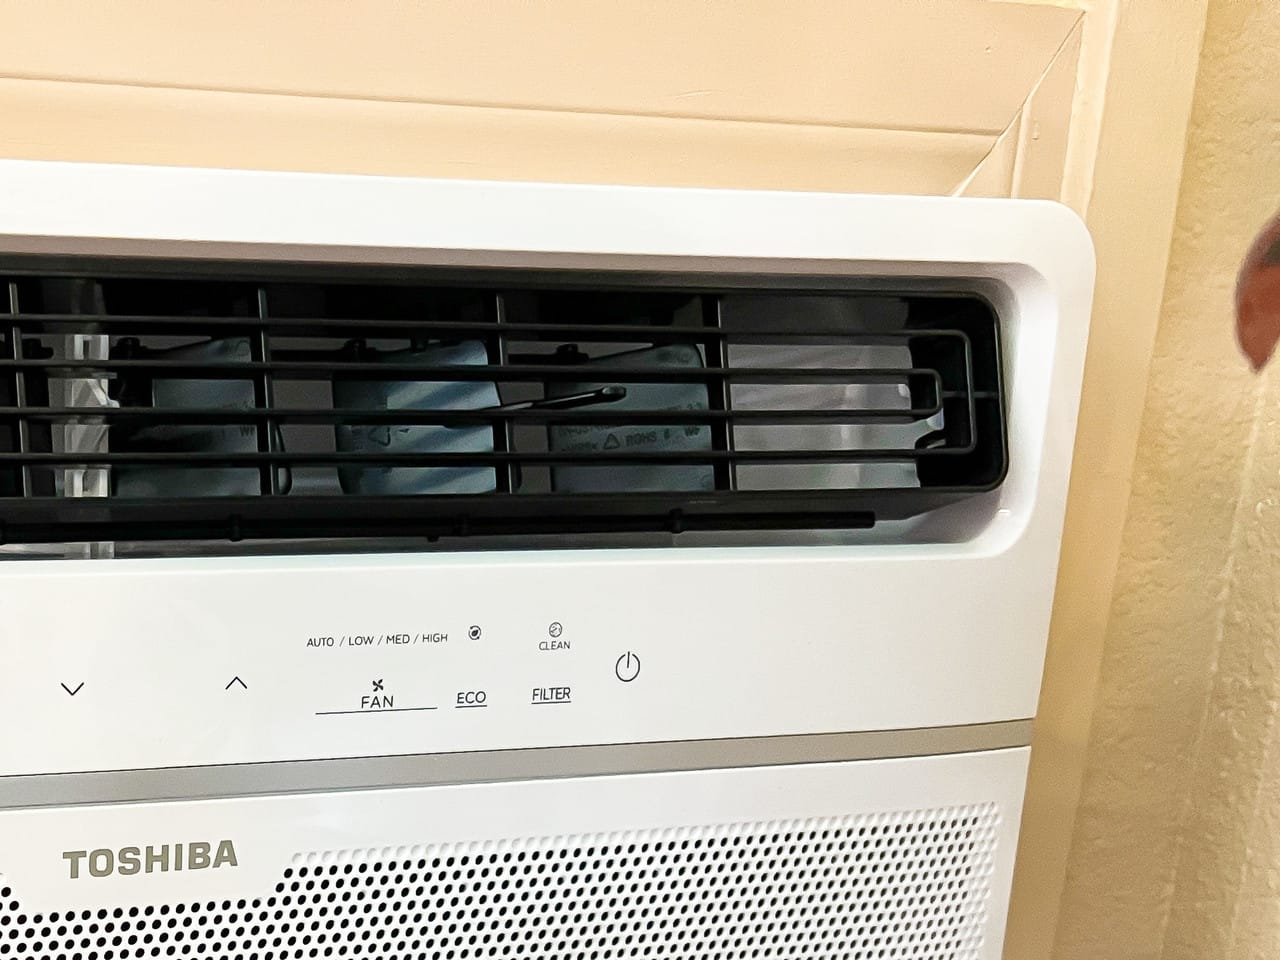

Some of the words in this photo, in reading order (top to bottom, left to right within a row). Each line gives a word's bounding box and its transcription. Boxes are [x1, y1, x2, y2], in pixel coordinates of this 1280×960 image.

[306, 636, 335, 648] AUTO
[348, 635, 375, 647] LOW
[385, 633, 411, 646] MED
[421, 632, 449, 644] HIGH
[538, 640, 571, 651] CLEAN
[456, 690, 487, 705] ECO
[531, 686, 572, 701] FILTER
[360, 695, 394, 710] FAN
[62, 839, 239, 880] TOSHIBA
